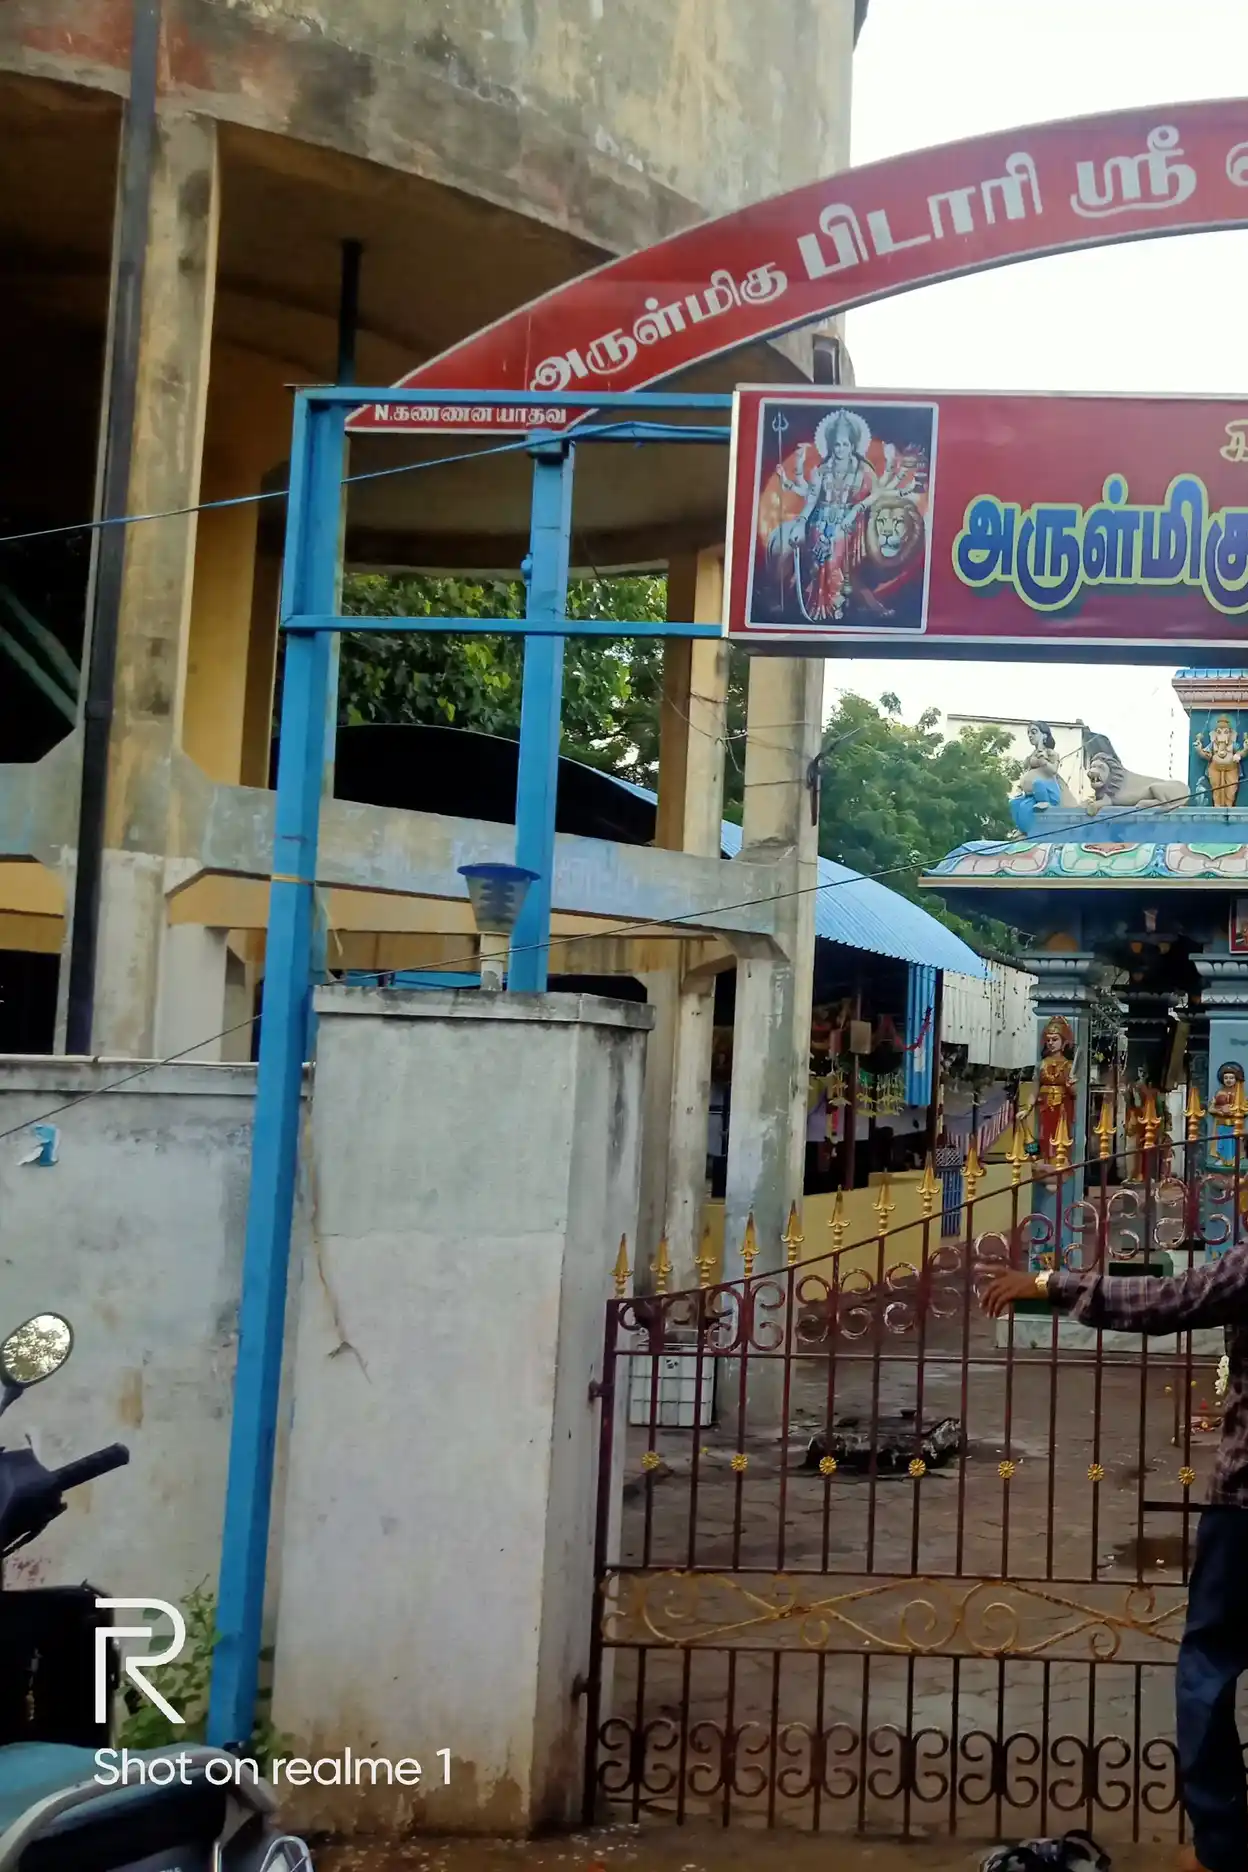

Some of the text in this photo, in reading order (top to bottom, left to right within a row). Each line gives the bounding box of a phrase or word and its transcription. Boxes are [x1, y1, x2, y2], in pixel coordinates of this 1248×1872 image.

[528, 260, 789, 391] அருள்மிகு
[797, 150, 1043, 279] பிடாரி
[1069, 124, 1198, 219] ஸ்ரீ
